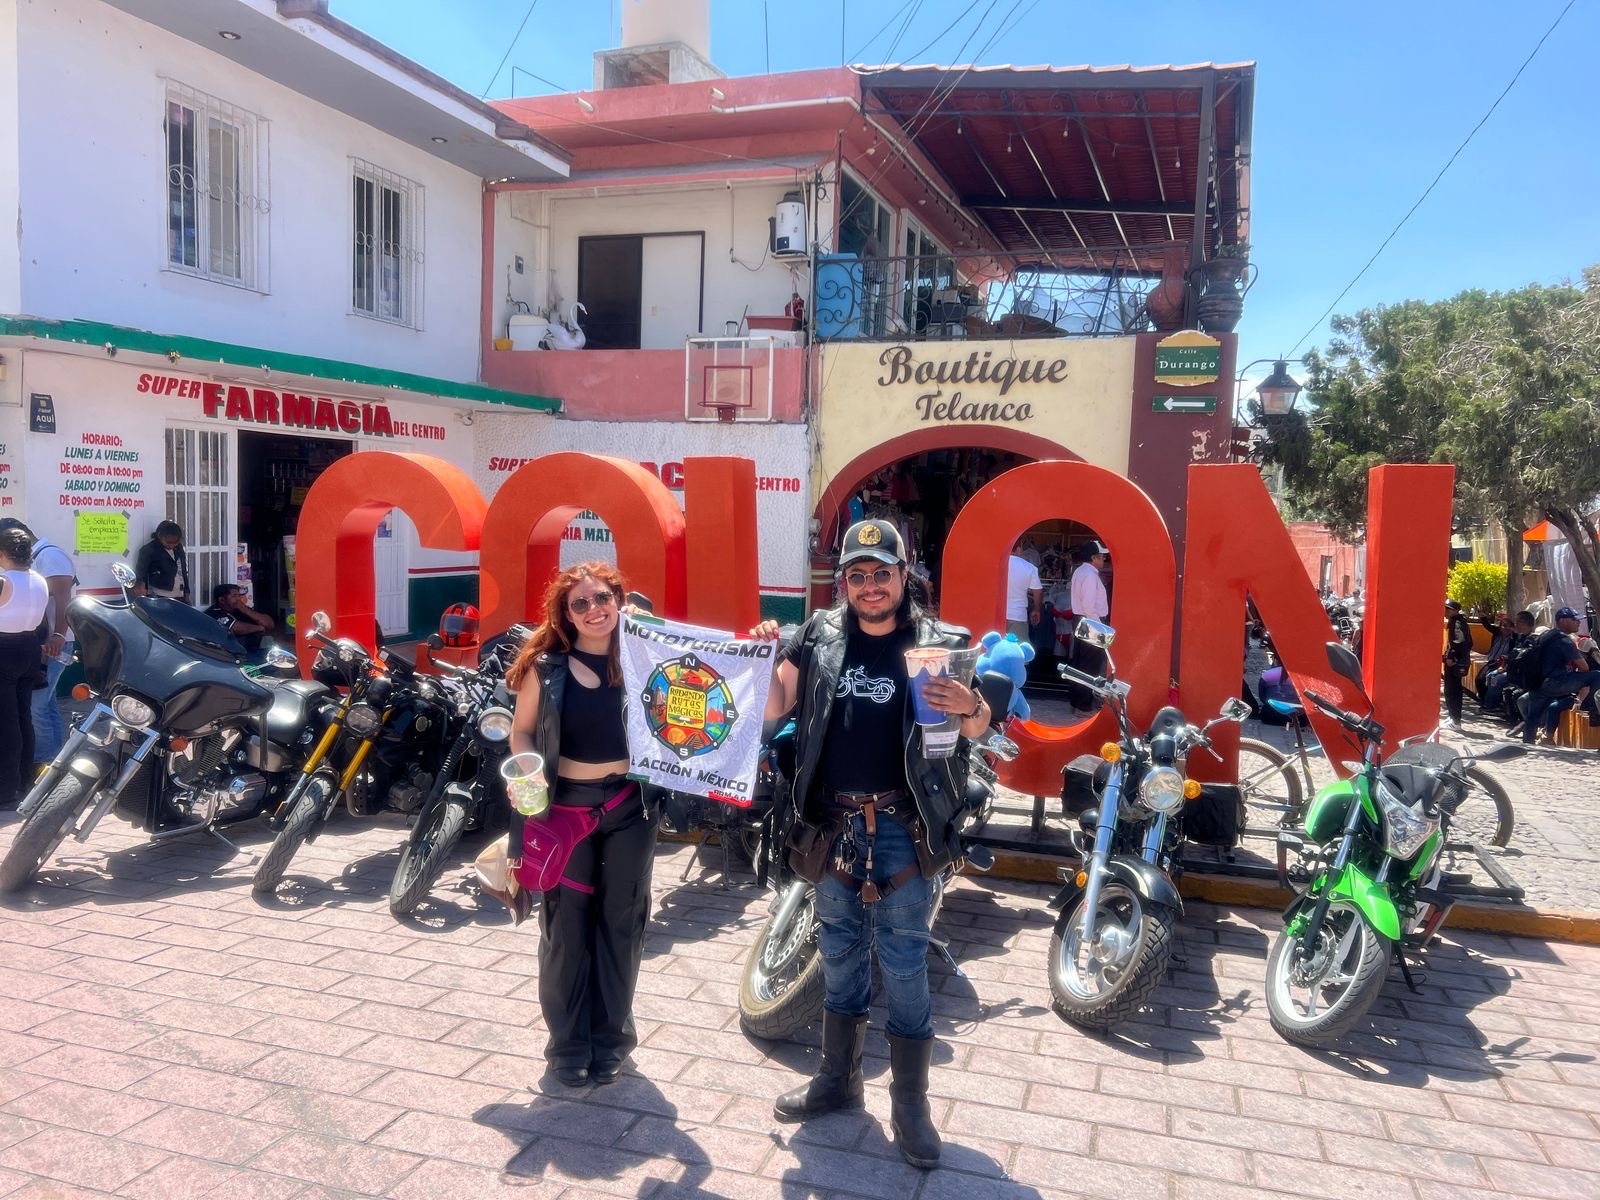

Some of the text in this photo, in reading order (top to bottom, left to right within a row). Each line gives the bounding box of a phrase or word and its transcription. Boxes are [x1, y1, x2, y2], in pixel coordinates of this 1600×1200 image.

[878, 346, 1068, 395] Boutique
[1159, 360, 1216, 370] Durango
[136, 374, 446, 441] SUPER FARMACIA DEL CENTRO
[915, 391, 1034, 421] Telanco
[82, 433, 123, 447] HORARIO:
[64, 447, 139, 462] LUNES A VIERNES
[60, 463, 143, 479] DE 08:00 am A 10:00 pm
[489, 456, 534, 472] SUPE
[64, 479, 141, 493] SABADO Y DOMINGO
[59, 494, 145, 509] DE 09:00 am A 09:00 pm
[623, 619, 773, 659] MOTOTURISMO
[685, 657, 696, 668] N
[726, 710, 735, 719] E
[679, 748, 689, 757] S
[638, 757, 693, 778] ACCIÓN
[696, 769, 749, 793] MÉXICO
